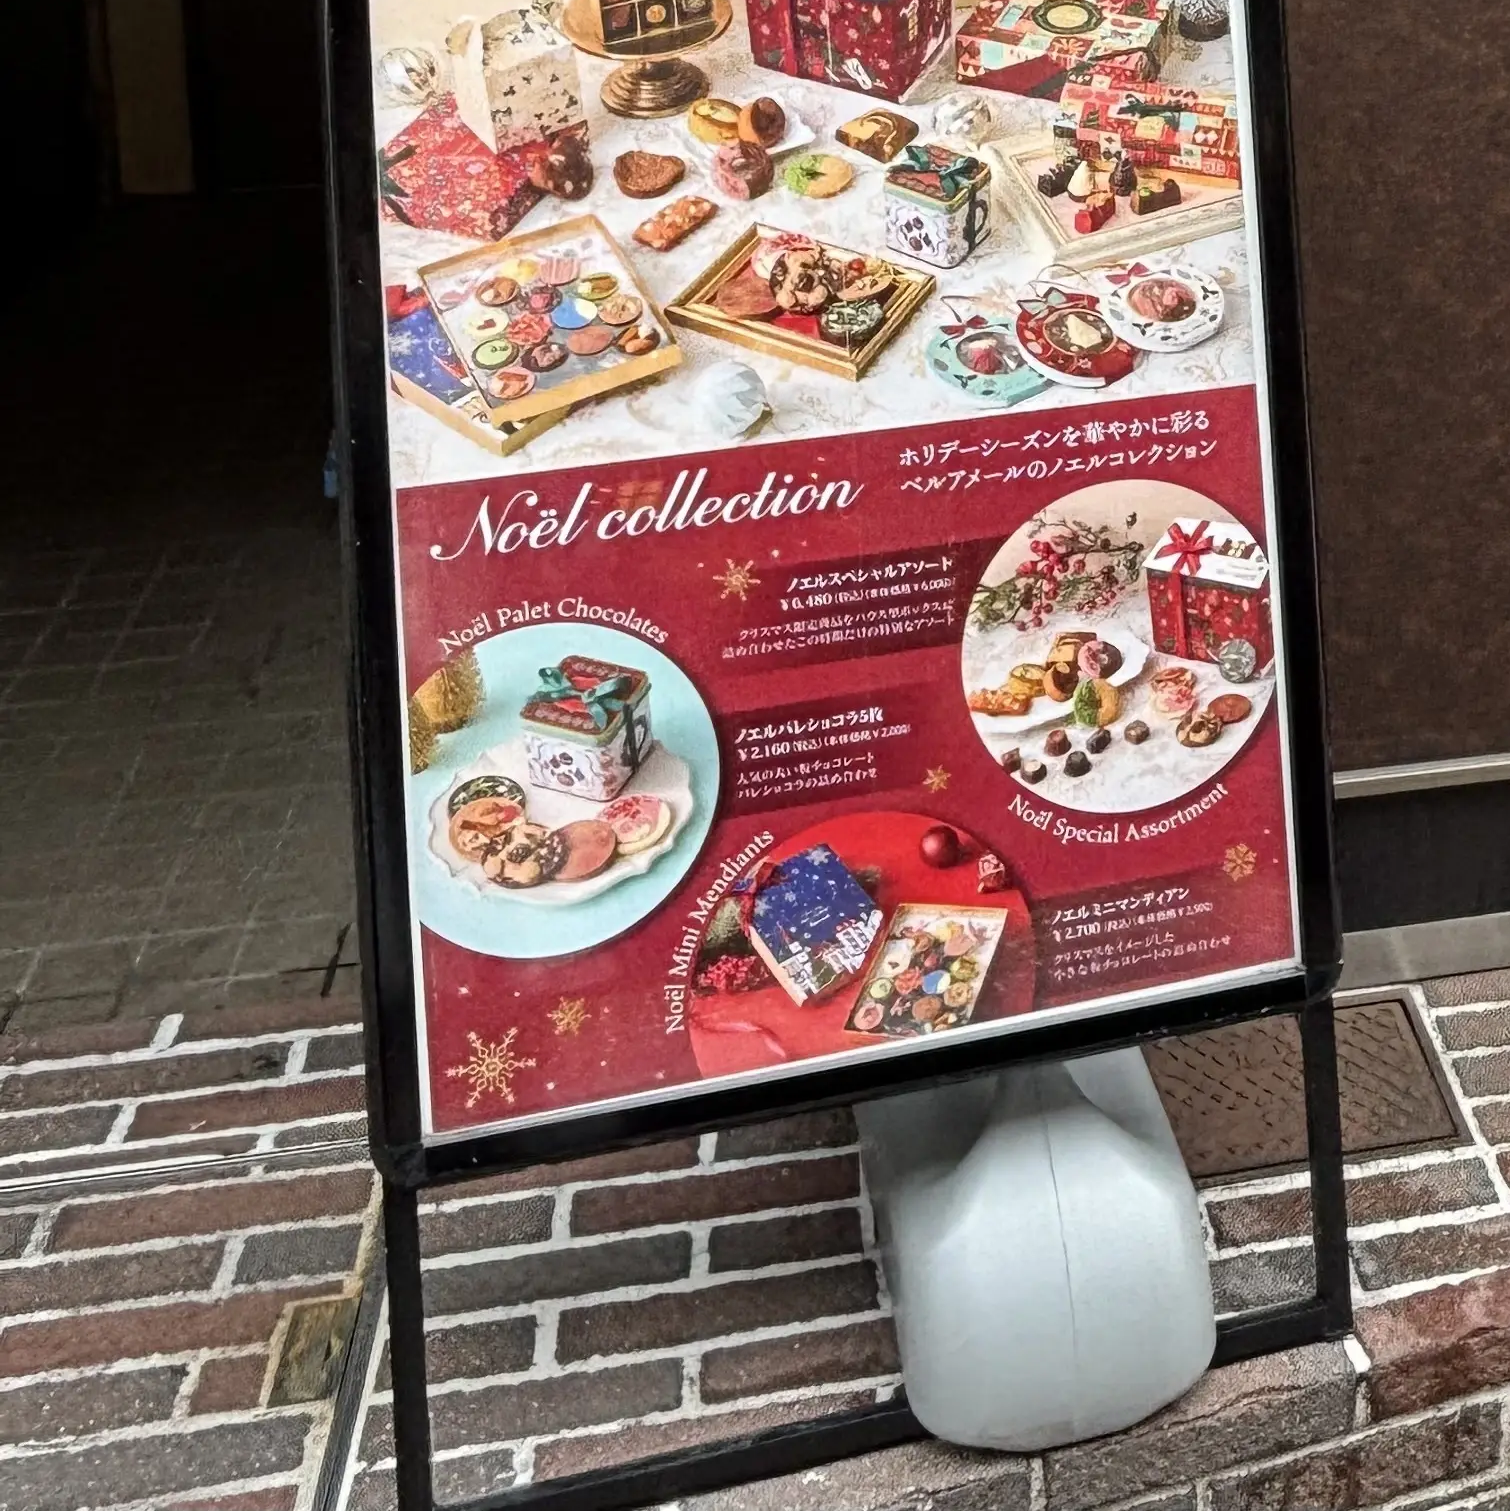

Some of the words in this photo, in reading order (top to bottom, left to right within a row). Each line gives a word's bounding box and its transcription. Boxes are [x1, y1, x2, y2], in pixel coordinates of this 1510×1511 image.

[899, 409, 1210, 468] ホリデーシーズンを華やかに彩る
[900, 440, 1218, 494] ベルアメールのノエルコレクション
[429, 482, 593, 561] Noël
[597, 468, 864, 541] collection
[438, 612, 492, 655] Noël
[497, 600, 551, 628] Palet
[557, 596, 669, 645] Chocolates
[1007, 794, 1053, 831] Noël
[1053, 817, 1119, 844] Special
[1124, 782, 1229, 842] Assortment
[688, 831, 774, 924] Mendiants
[669, 926, 700, 977] Mini
[664, 985, 686, 1035] Noël
